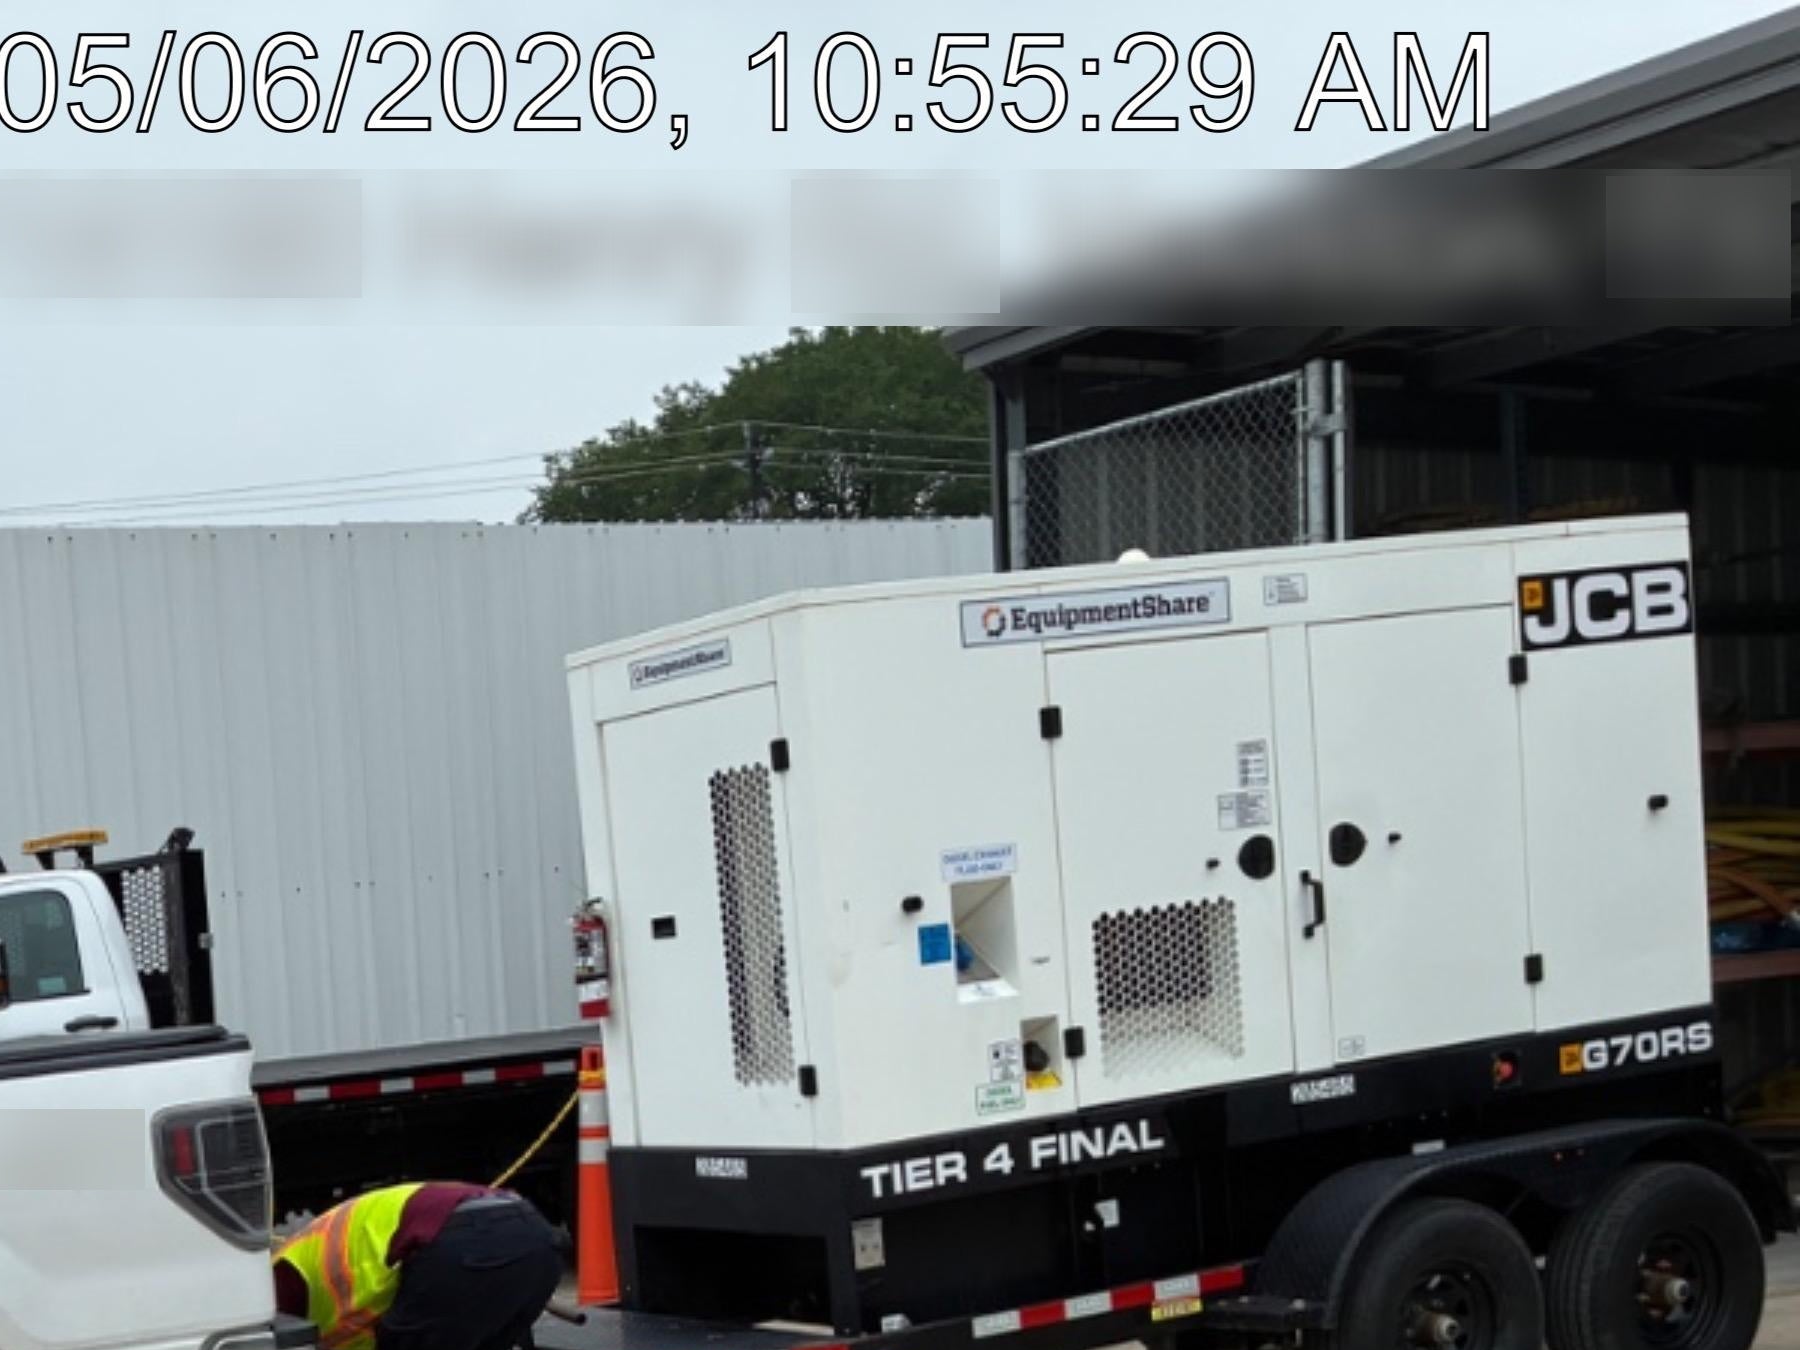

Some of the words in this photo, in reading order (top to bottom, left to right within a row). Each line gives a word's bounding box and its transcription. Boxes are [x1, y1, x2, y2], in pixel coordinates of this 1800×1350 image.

[1010, 593, 1210, 634] EquipmentShare
[1523, 567, 1689, 645] JCB
[1582, 1022, 1713, 1071] G70RS
[860, 1151, 968, 1198] TIER
[983, 1142, 1015, 1175] 4
[1030, 1119, 1166, 1169] FINAL
